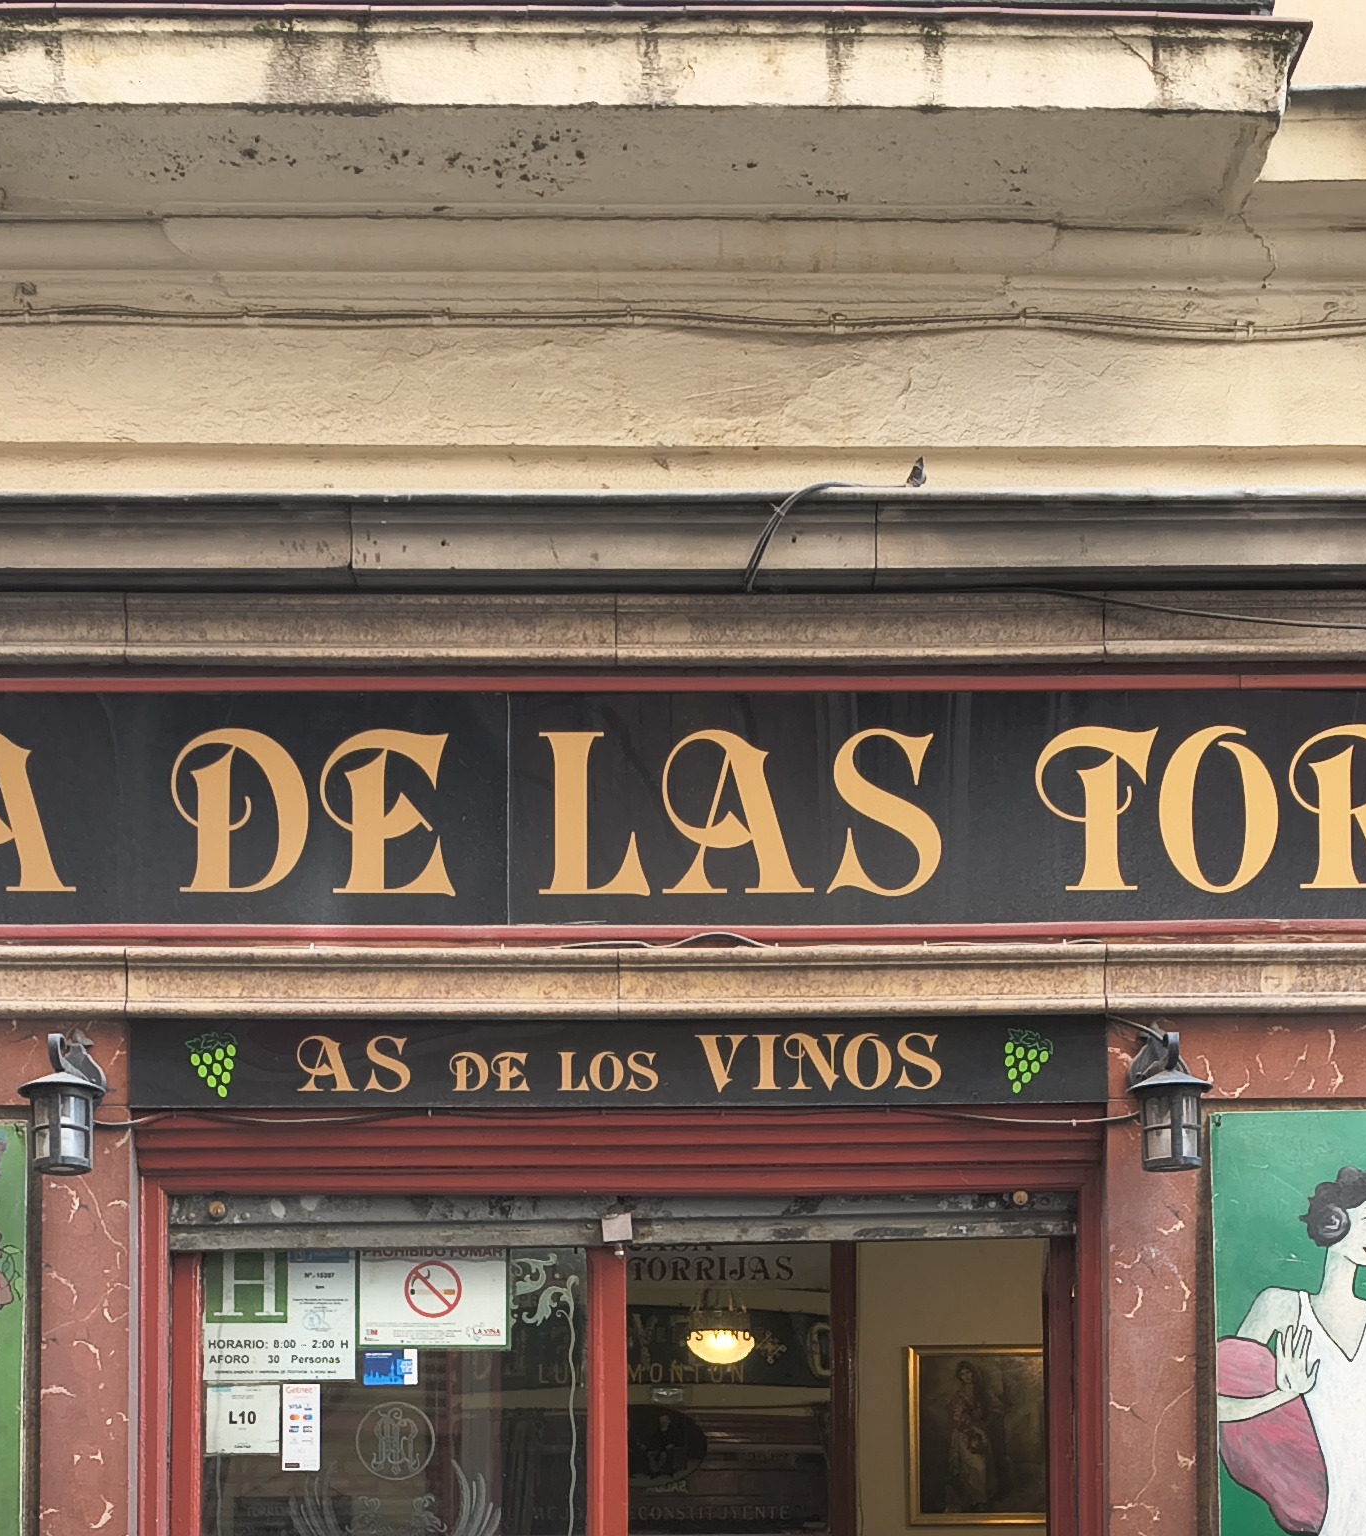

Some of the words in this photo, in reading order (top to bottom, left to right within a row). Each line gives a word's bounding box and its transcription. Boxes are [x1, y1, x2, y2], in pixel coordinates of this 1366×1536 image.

[170, 728, 456, 897] DE
[539, 728, 943, 897] LAS
[296, 1033, 413, 1095] AS
[449, 1051, 531, 1094] DE
[556, 1049, 659, 1094] LOS
[694, 1033, 943, 1094] VINOS
[627, 1256, 795, 1281] TORRIJAS
[213, 1250, 285, 1317] H
[208, 1339, 269, 1350] HORARIO:
[273, 1339, 296, 1349] 8:00
[311, 1339, 335, 1349] 2:00
[340, 1339, 349, 1349] H
[268, 1354, 280, 1364] 30
[291, 1354, 341, 1364] Personas
[228, 1410, 257, 1425] L10
